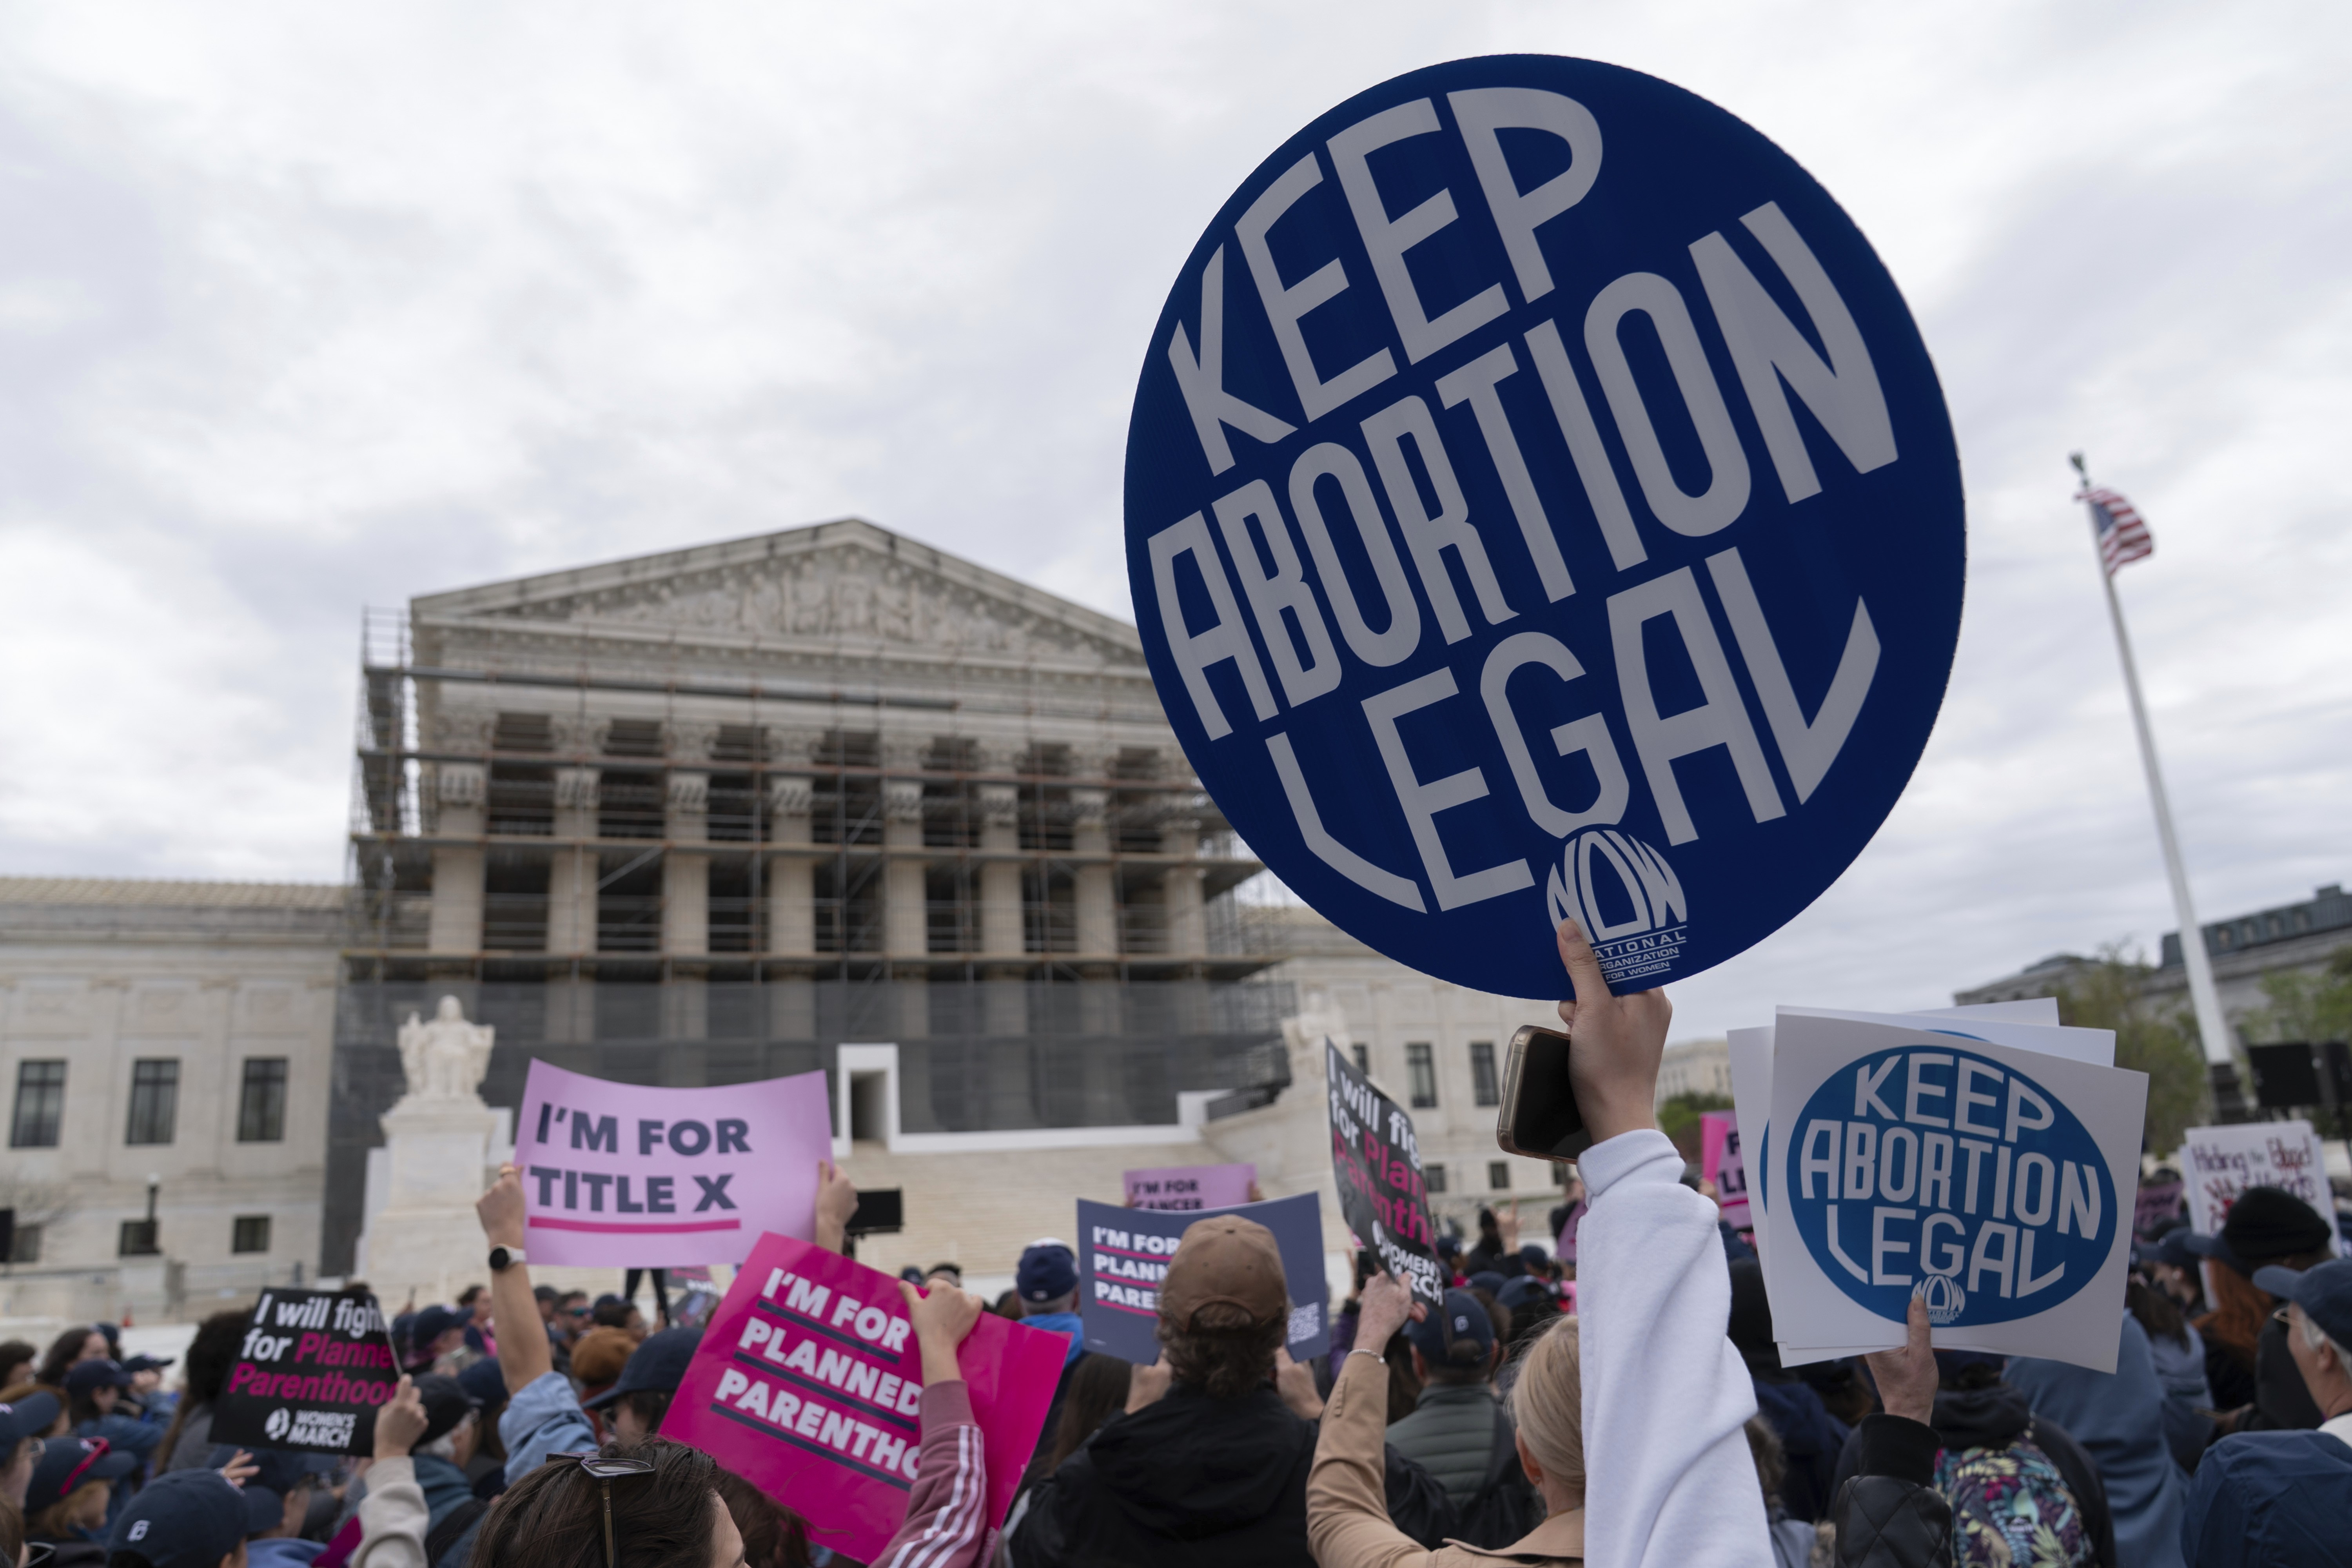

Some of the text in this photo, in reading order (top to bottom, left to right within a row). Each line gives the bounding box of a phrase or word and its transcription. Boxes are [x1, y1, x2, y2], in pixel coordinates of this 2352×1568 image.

[1168, 87, 1603, 477] KEEP
[1147, 201, 1898, 741] ABORTION
[1265, 546, 1881, 914] LEGAL
[1547, 830, 1687, 943] NOW
[1594, 931, 1686, 958] ATIONAL
[1599, 947, 1679, 970] RGANIZATION
[1606, 961, 1670, 980] FOR WOMEN
[536, 1102, 753, 1156] I'M FOR
[1328, 1047, 1421, 1171] I will fig
[1854, 1053, 2055, 1143] KEEP
[530, 1165, 738, 1214] TITLE X
[1165, 1180, 1199, 1192] FOR
[1330, 1089, 1427, 1205] for Plan
[1334, 1129, 1430, 1246] Parenth
[1800, 1119, 2102, 1240] ABORTION
[1093, 1226, 1130, 1249] I'M
[1093, 1253, 1169, 1282] PLANN
[1826, 1204, 2065, 1298] LEGAL
[241, 1327, 396, 1368] for Planne
[254, 1293, 383, 1339] I will figh
[762, 1267, 911, 1353] I'M FOR
[737, 1316, 924, 1416] PLANNED
[287, 1425, 352, 1448] MARCH
[294, 1410, 357, 1428] WOMEN'S
[714, 1368, 920, 1480] PARENTHO
